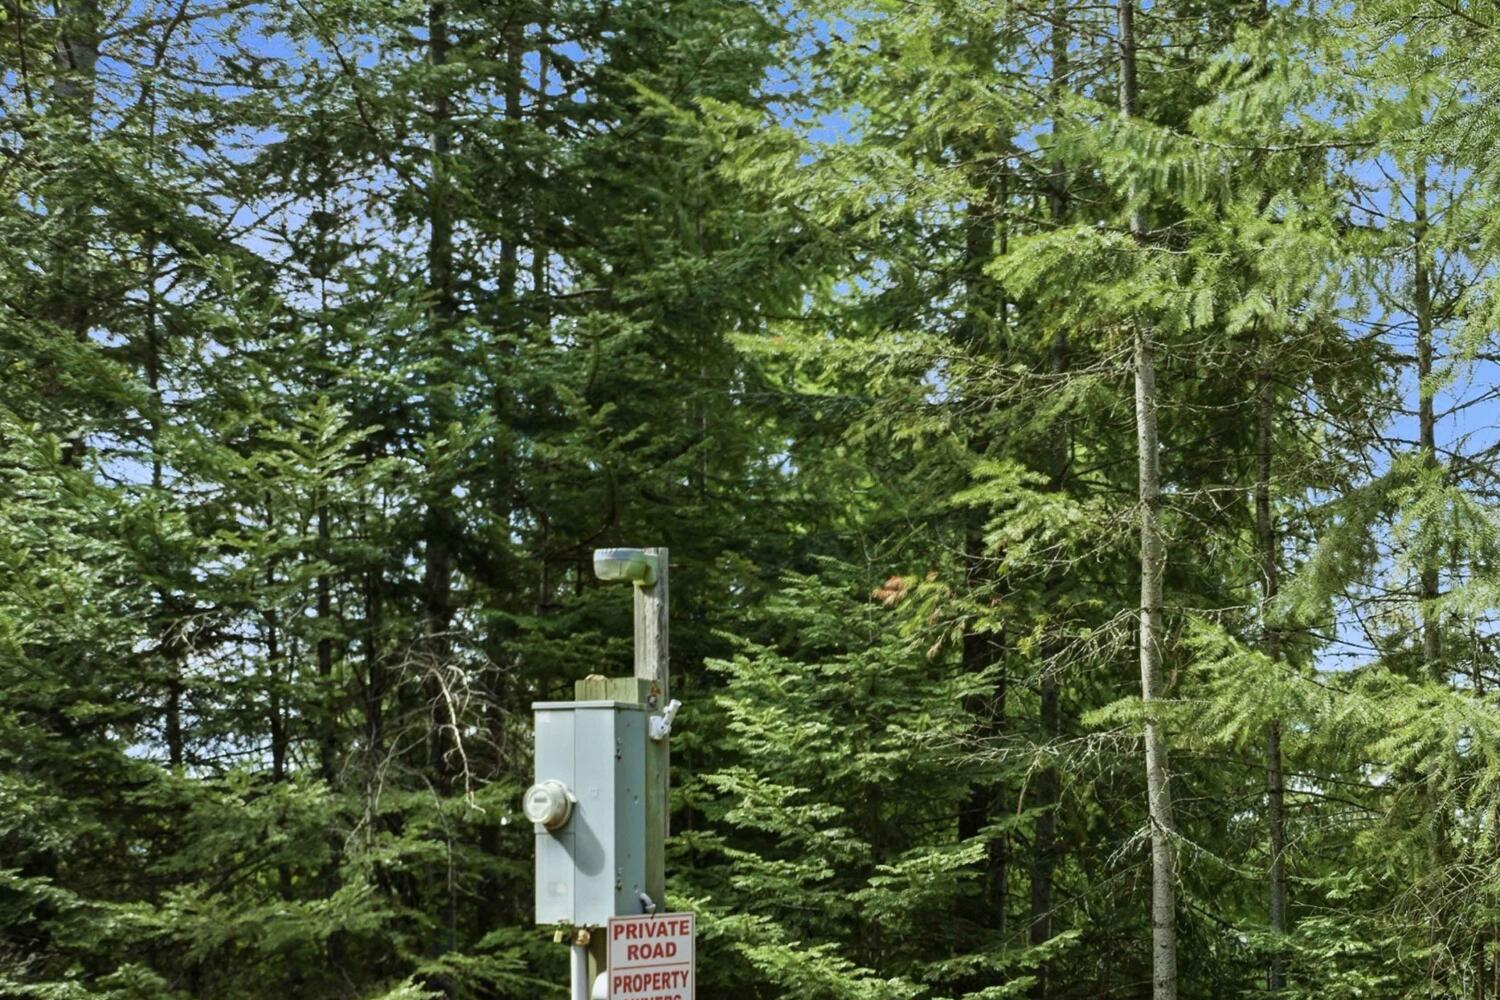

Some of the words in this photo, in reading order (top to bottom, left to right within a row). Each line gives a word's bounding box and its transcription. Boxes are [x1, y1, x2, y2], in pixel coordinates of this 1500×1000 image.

[613, 919, 690, 941] PRIVATE
[627, 941, 677, 961] ROAD
[613, 970, 689, 995] PROPERTY
